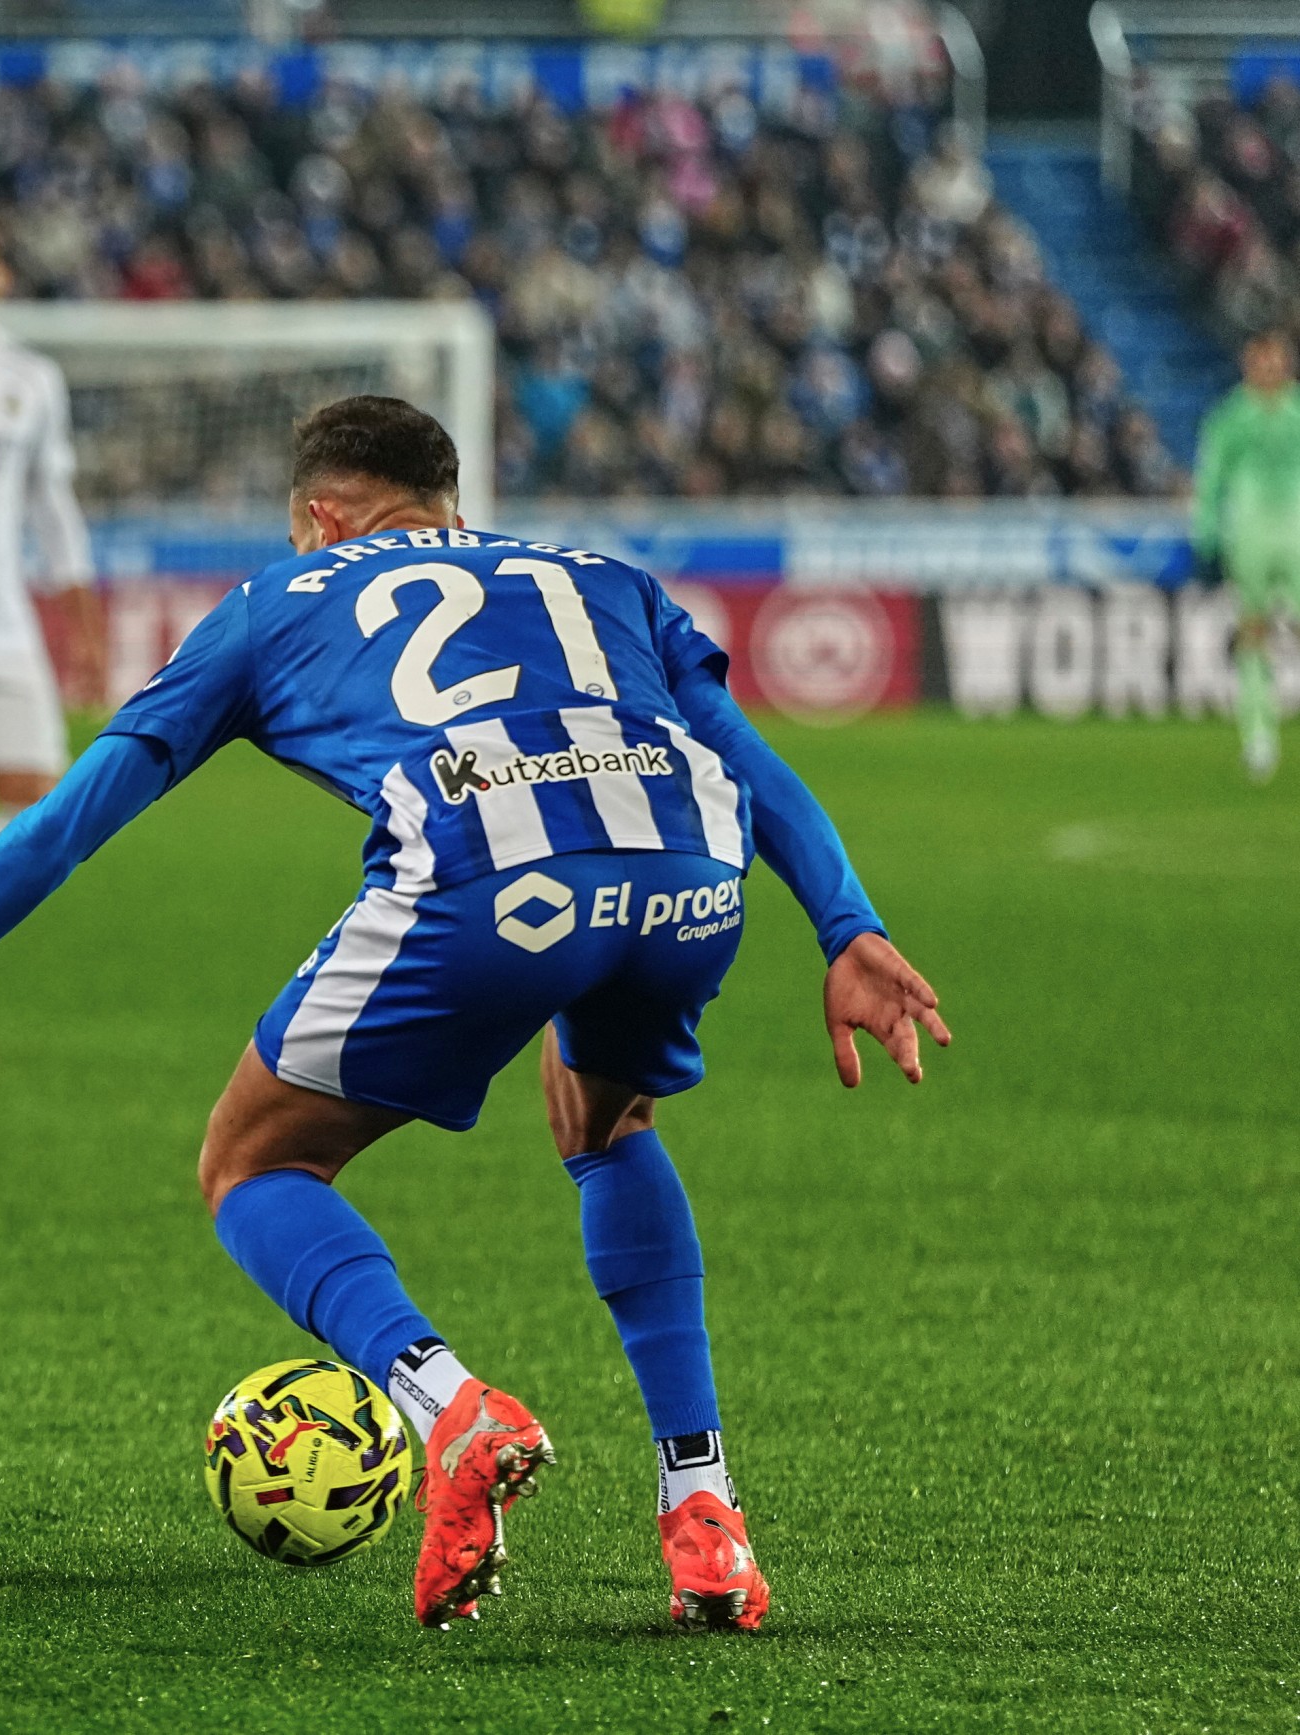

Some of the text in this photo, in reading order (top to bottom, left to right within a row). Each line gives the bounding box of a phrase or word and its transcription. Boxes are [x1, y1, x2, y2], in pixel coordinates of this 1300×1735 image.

[355, 557, 619, 727] 21
[432, 745, 669, 801] Kutxabank
[589, 876, 741, 936] El proex
[676, 921, 720, 942] Grupo
[390, 1367, 447, 1418] PEDESIGN
